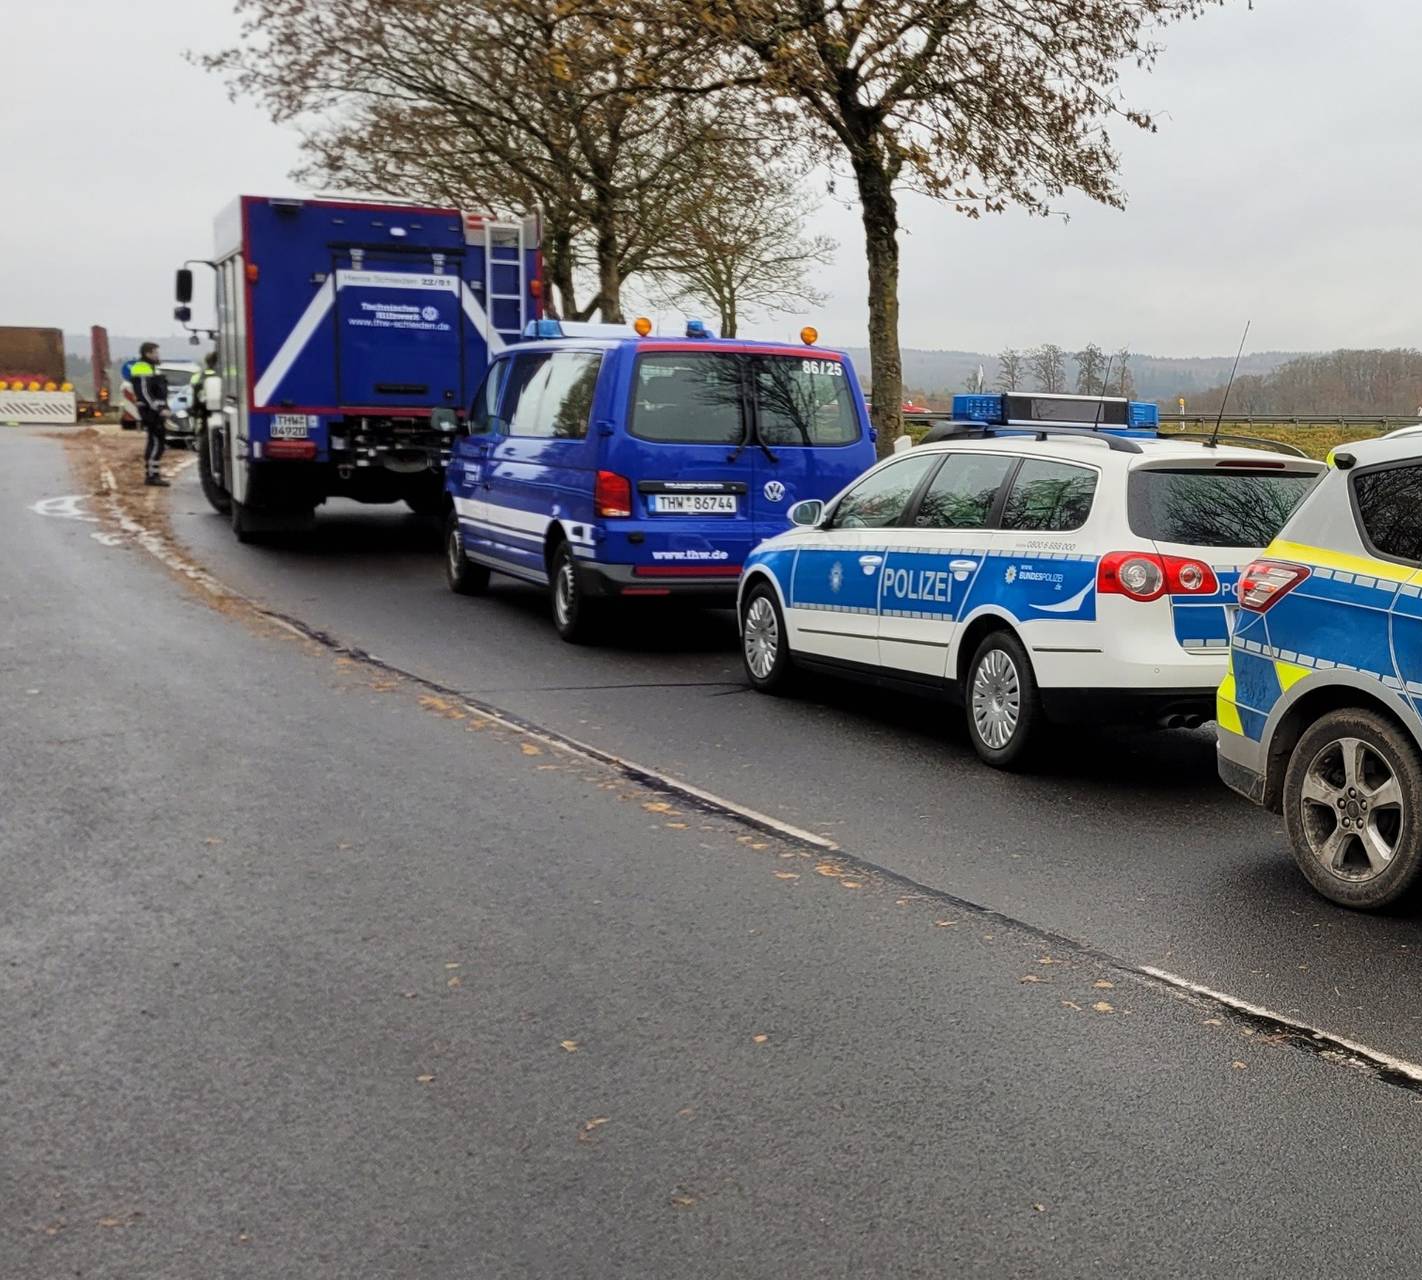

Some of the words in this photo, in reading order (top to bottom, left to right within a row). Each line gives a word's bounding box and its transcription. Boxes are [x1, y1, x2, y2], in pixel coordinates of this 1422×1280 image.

[802, 360, 842, 376] 86/25
[659, 496, 684, 509] THW
[694, 497, 732, 510] 86744
[652, 550, 729, 560] www.thw.de
[883, 567, 953, 602] POLIZEI
